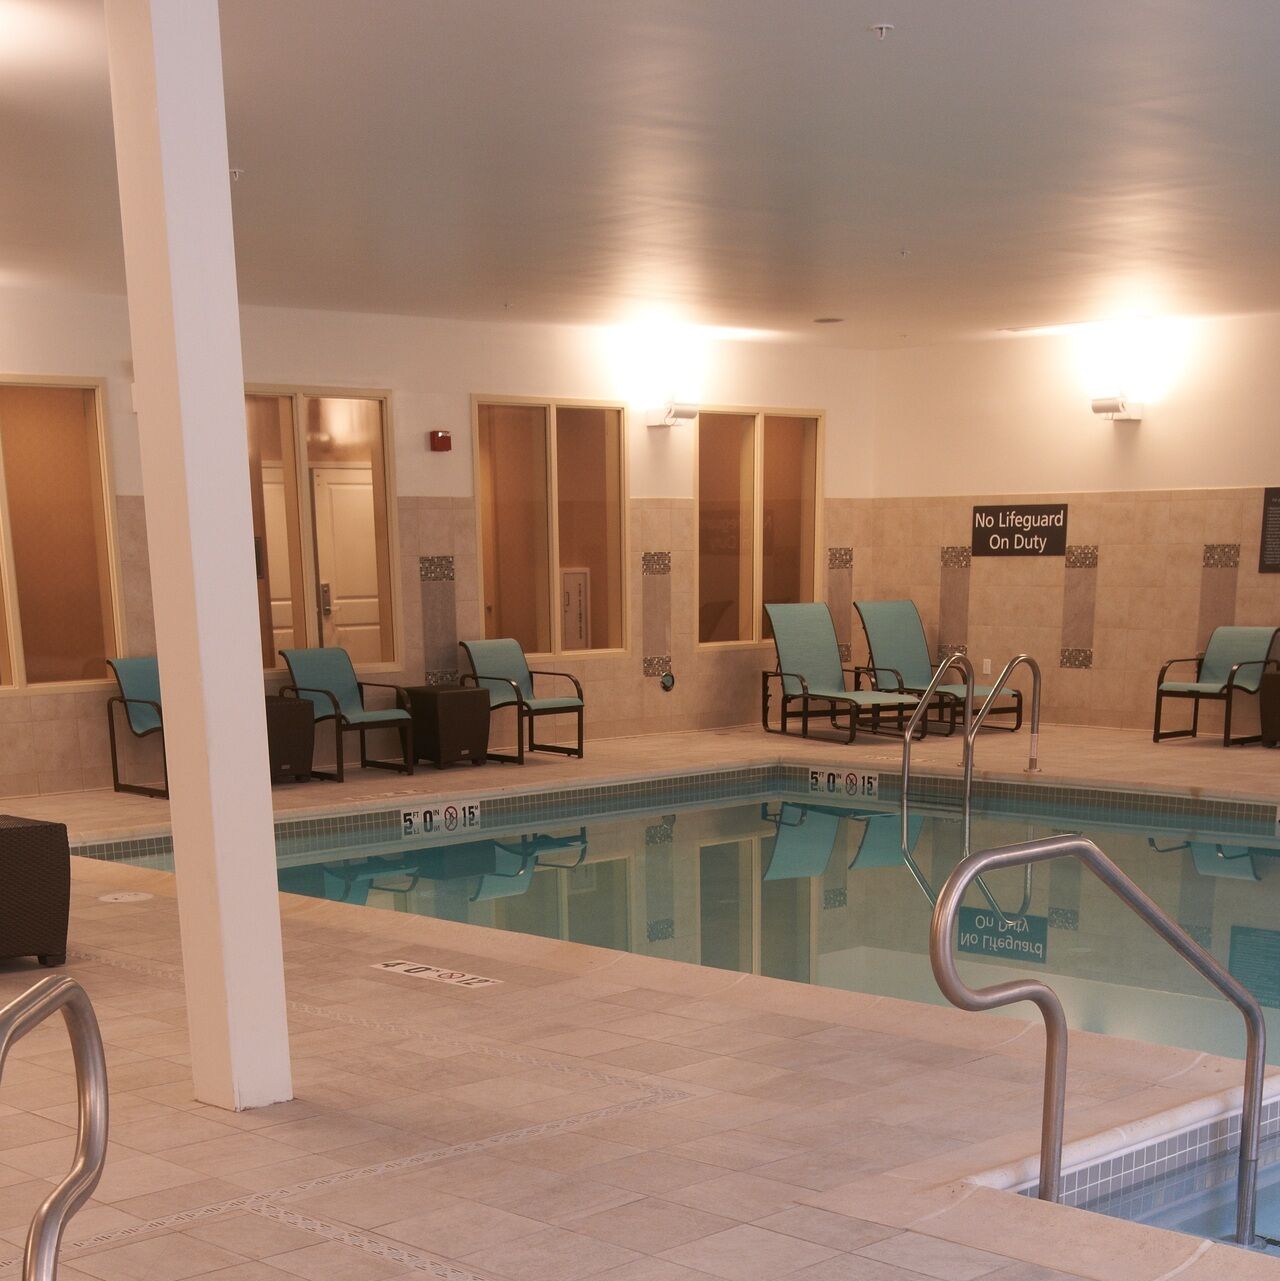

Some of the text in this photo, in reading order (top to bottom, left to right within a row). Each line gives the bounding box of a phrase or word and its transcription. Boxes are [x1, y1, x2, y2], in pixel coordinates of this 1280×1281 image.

[975, 510, 1064, 531] No Lifeguard
[989, 534, 1047, 553] On Duty
[810, 771, 819, 792] 5
[403, 812, 413, 836] 5
[423, 810, 434, 832] 0
